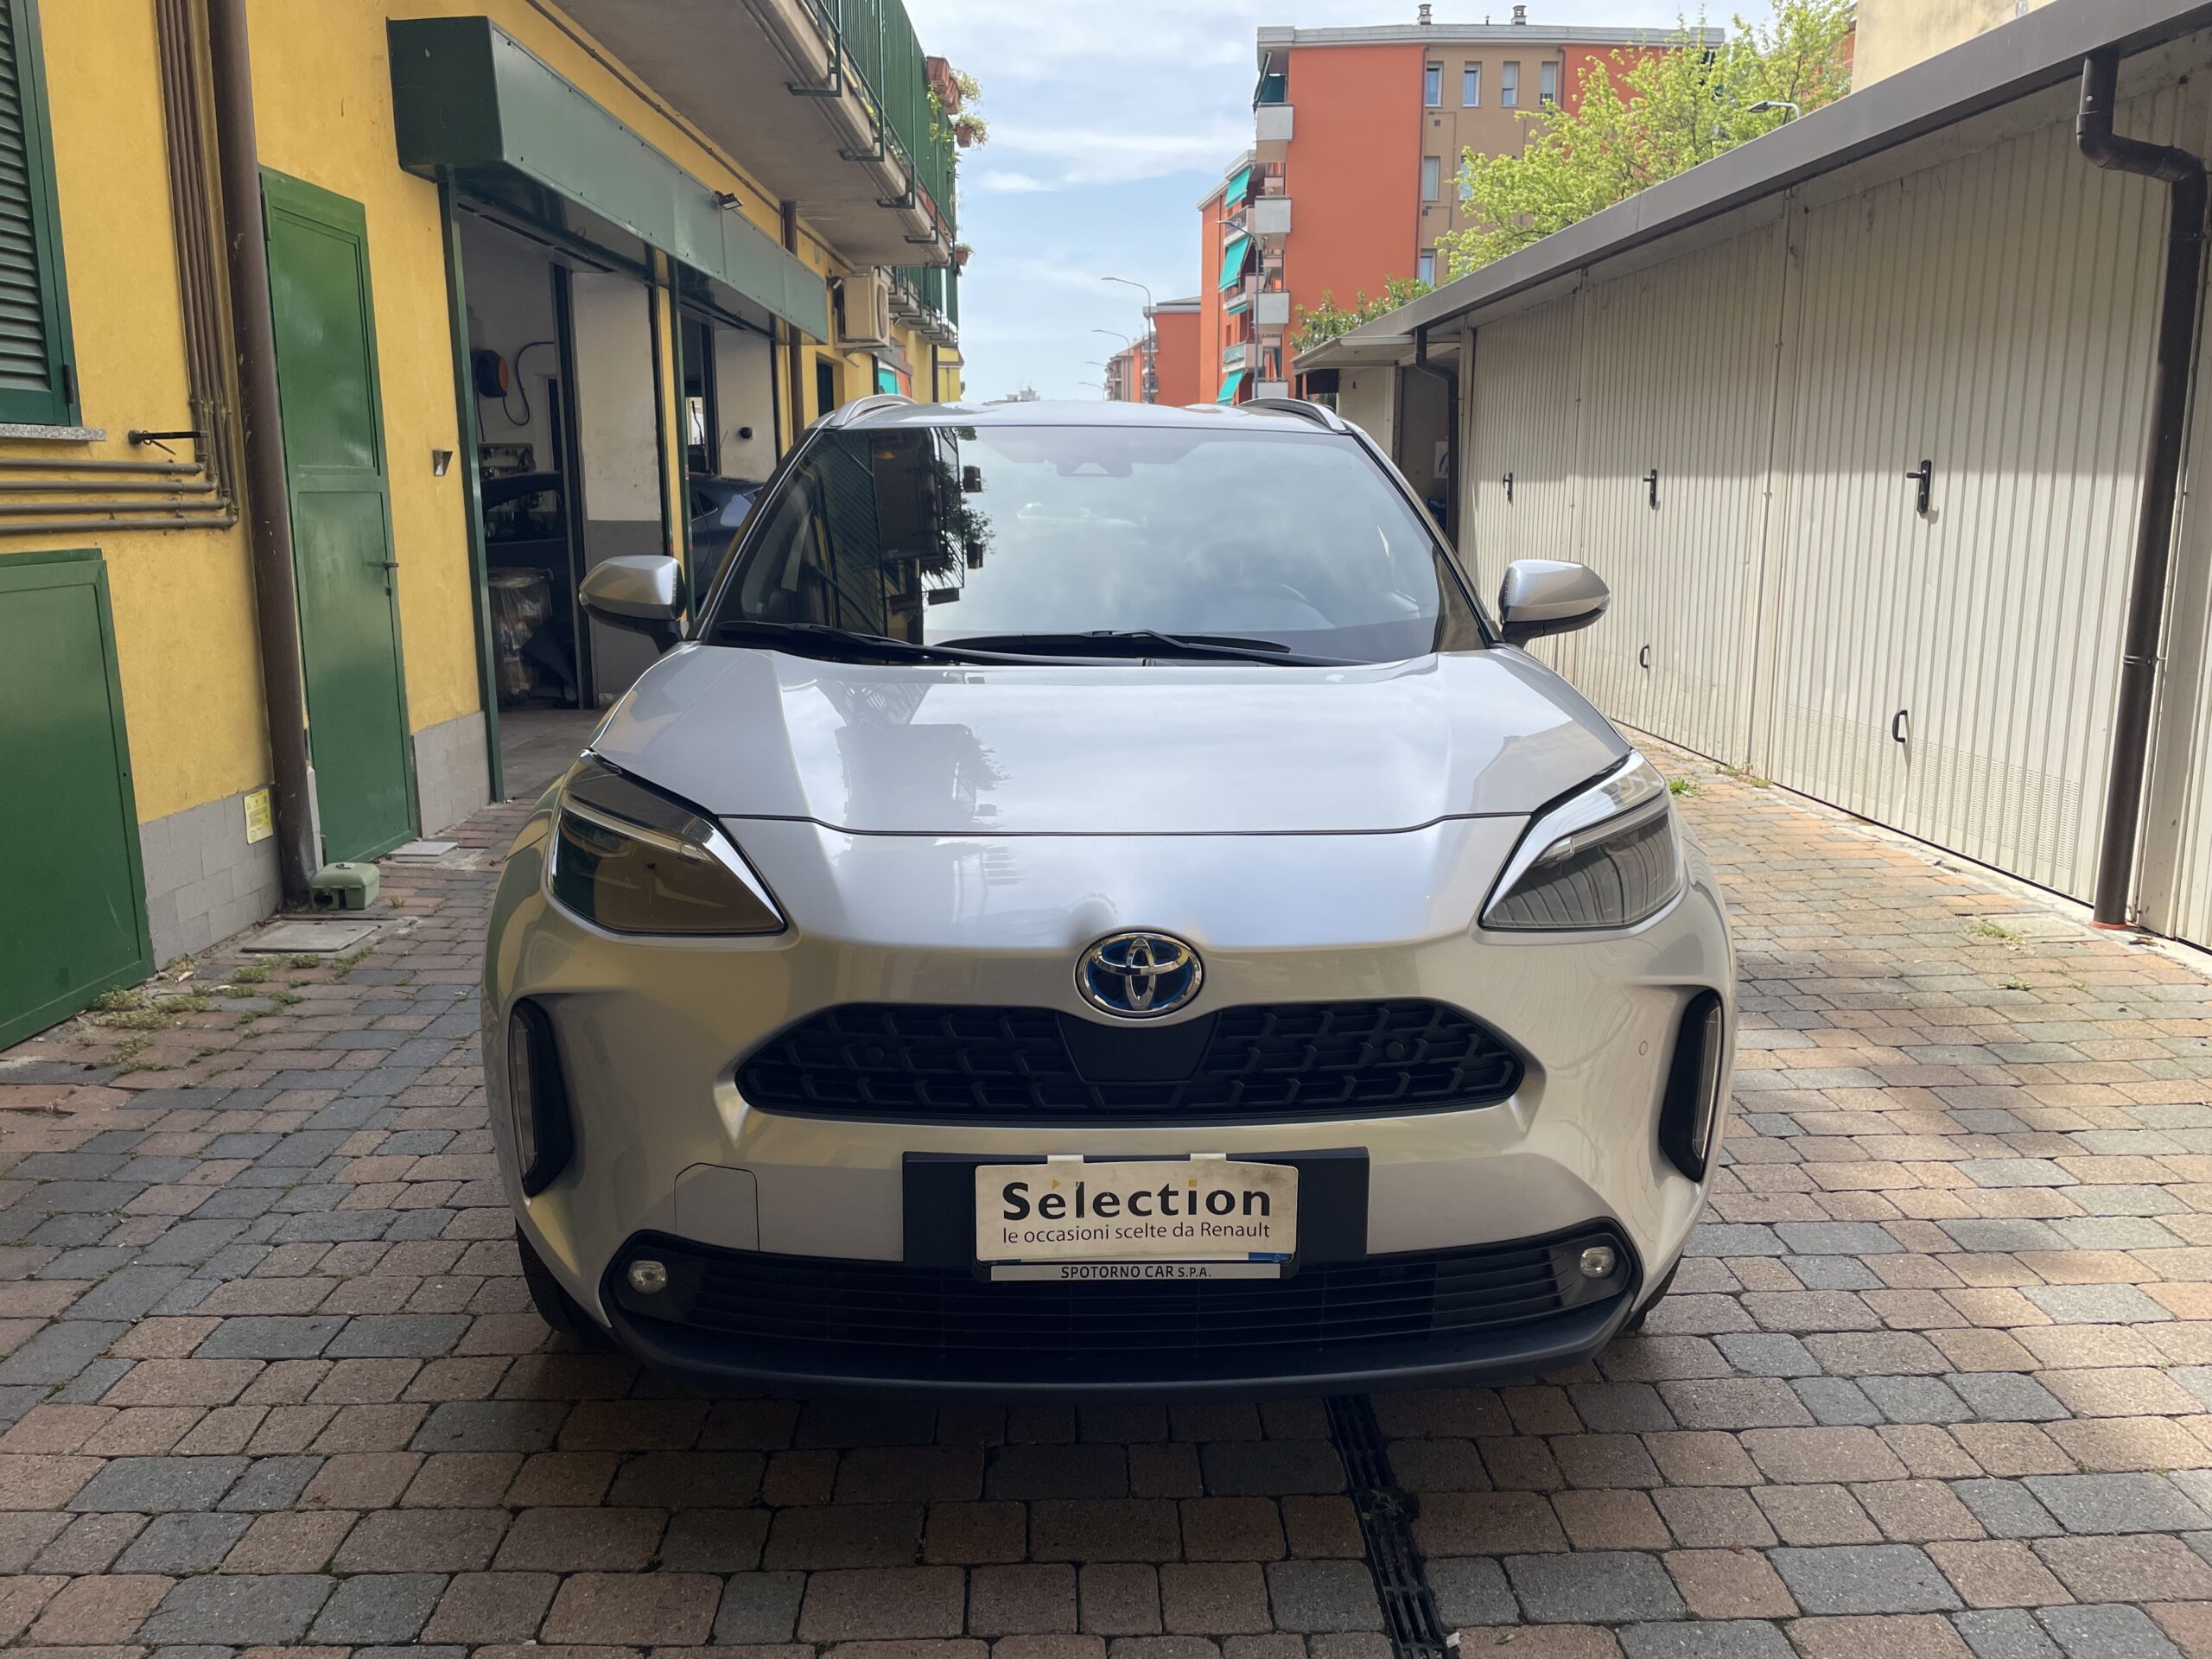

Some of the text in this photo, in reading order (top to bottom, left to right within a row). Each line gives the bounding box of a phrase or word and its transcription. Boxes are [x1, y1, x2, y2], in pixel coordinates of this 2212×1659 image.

[1003, 1222, 1270, 1243] le occasioni scelte da Renault
[1061, 1265, 1211, 1279] SPOTORNO CAR S.P.A.
